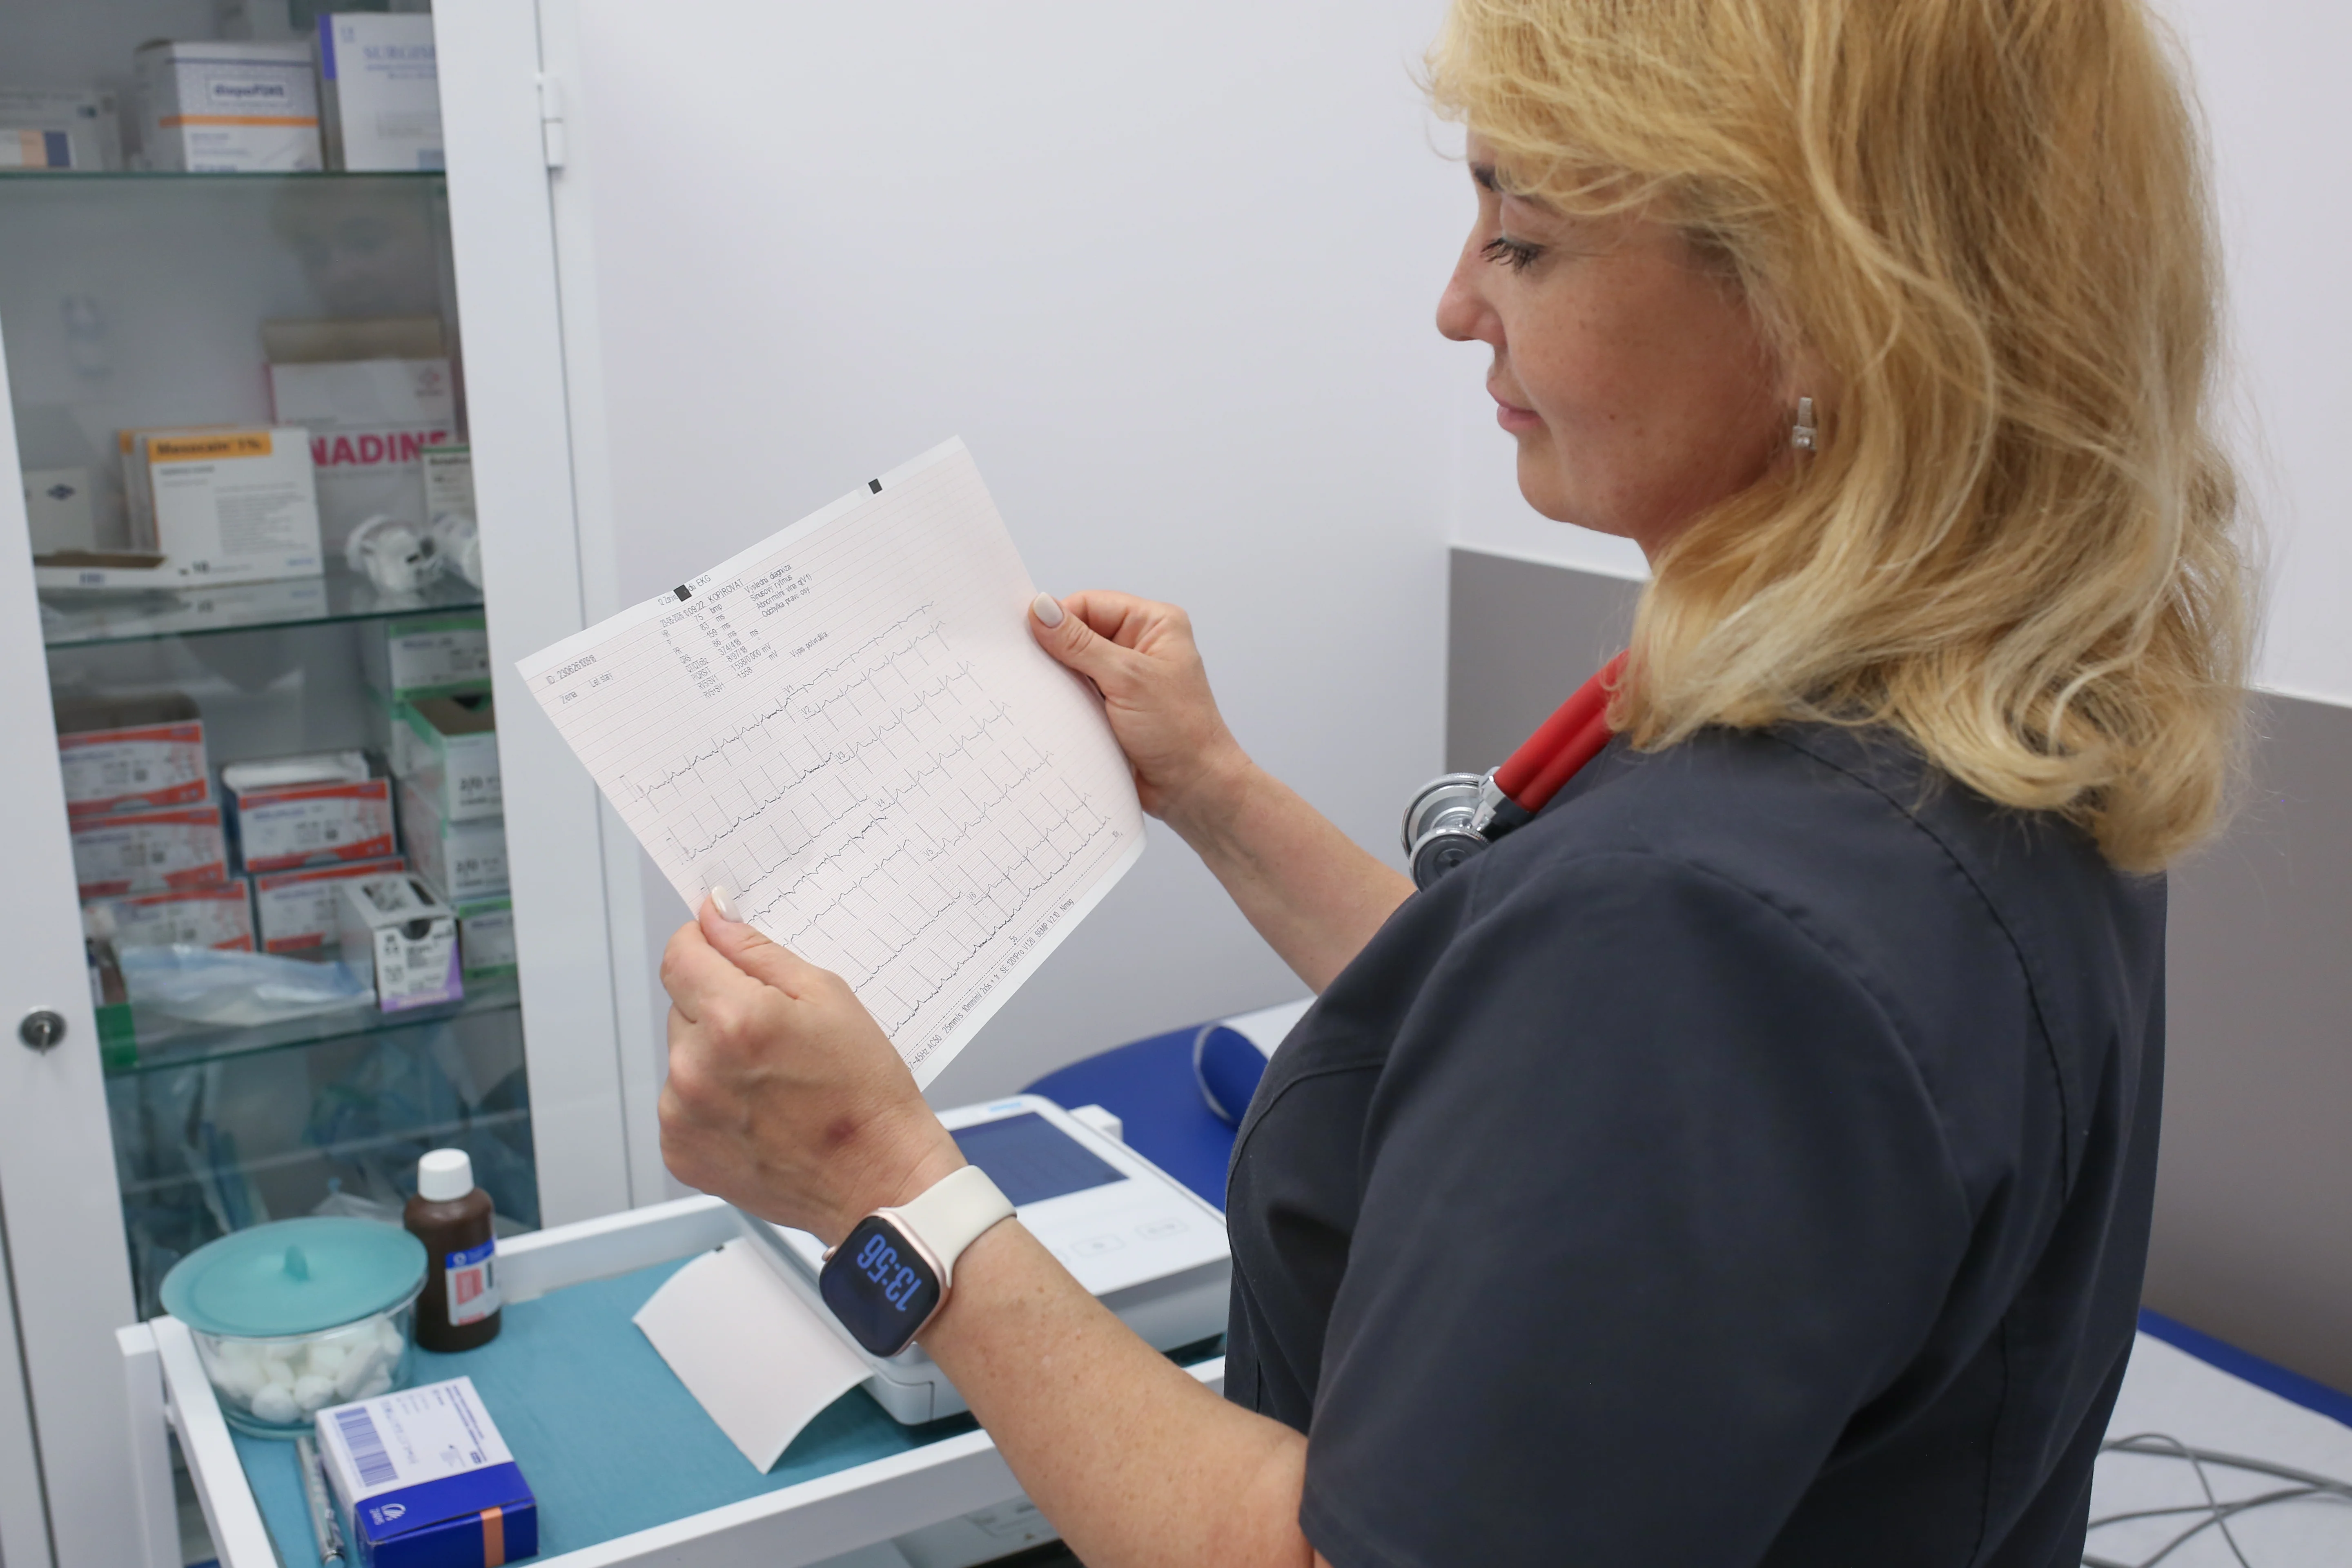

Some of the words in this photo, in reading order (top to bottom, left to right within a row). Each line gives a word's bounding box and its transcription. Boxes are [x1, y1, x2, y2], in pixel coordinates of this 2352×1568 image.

[696, 575, 711, 587] EKG
[774, 575, 793, 589] rytmus
[786, 582, 797, 592] vlna
[800, 586, 810, 596] osy
[694, 614, 704, 623] 75
[709, 604, 723, 614] bmp
[700, 622, 709, 631] 83
[716, 614, 726, 622] ms
[707, 629, 718, 639] 159
[722, 623, 731, 631] ms
[712, 638, 722, 648] 86
[727, 630, 737, 639] ms
[718, 638, 741, 655] 374/418
[750, 628, 759, 637] ms
[762, 642, 771, 653] mV
[768, 650, 779, 661] mV
[784, 684, 794, 694] V1
[801, 705, 811, 715] V2
[836, 751, 846, 762] V3
[875, 798, 886, 808] V4
[923, 848, 933, 858] V5
[967, 892, 977, 901] V6
[927, 1035, 942, 1049] AC50
[942, 1012, 964, 1034] 25mm/s
[962, 992, 983, 1013] 10mm/mV
[980, 982, 992, 994] 2x5s
[1000, 949, 1025, 974] SE-1201Pro
[856, 1234, 922, 1312] 13:56
